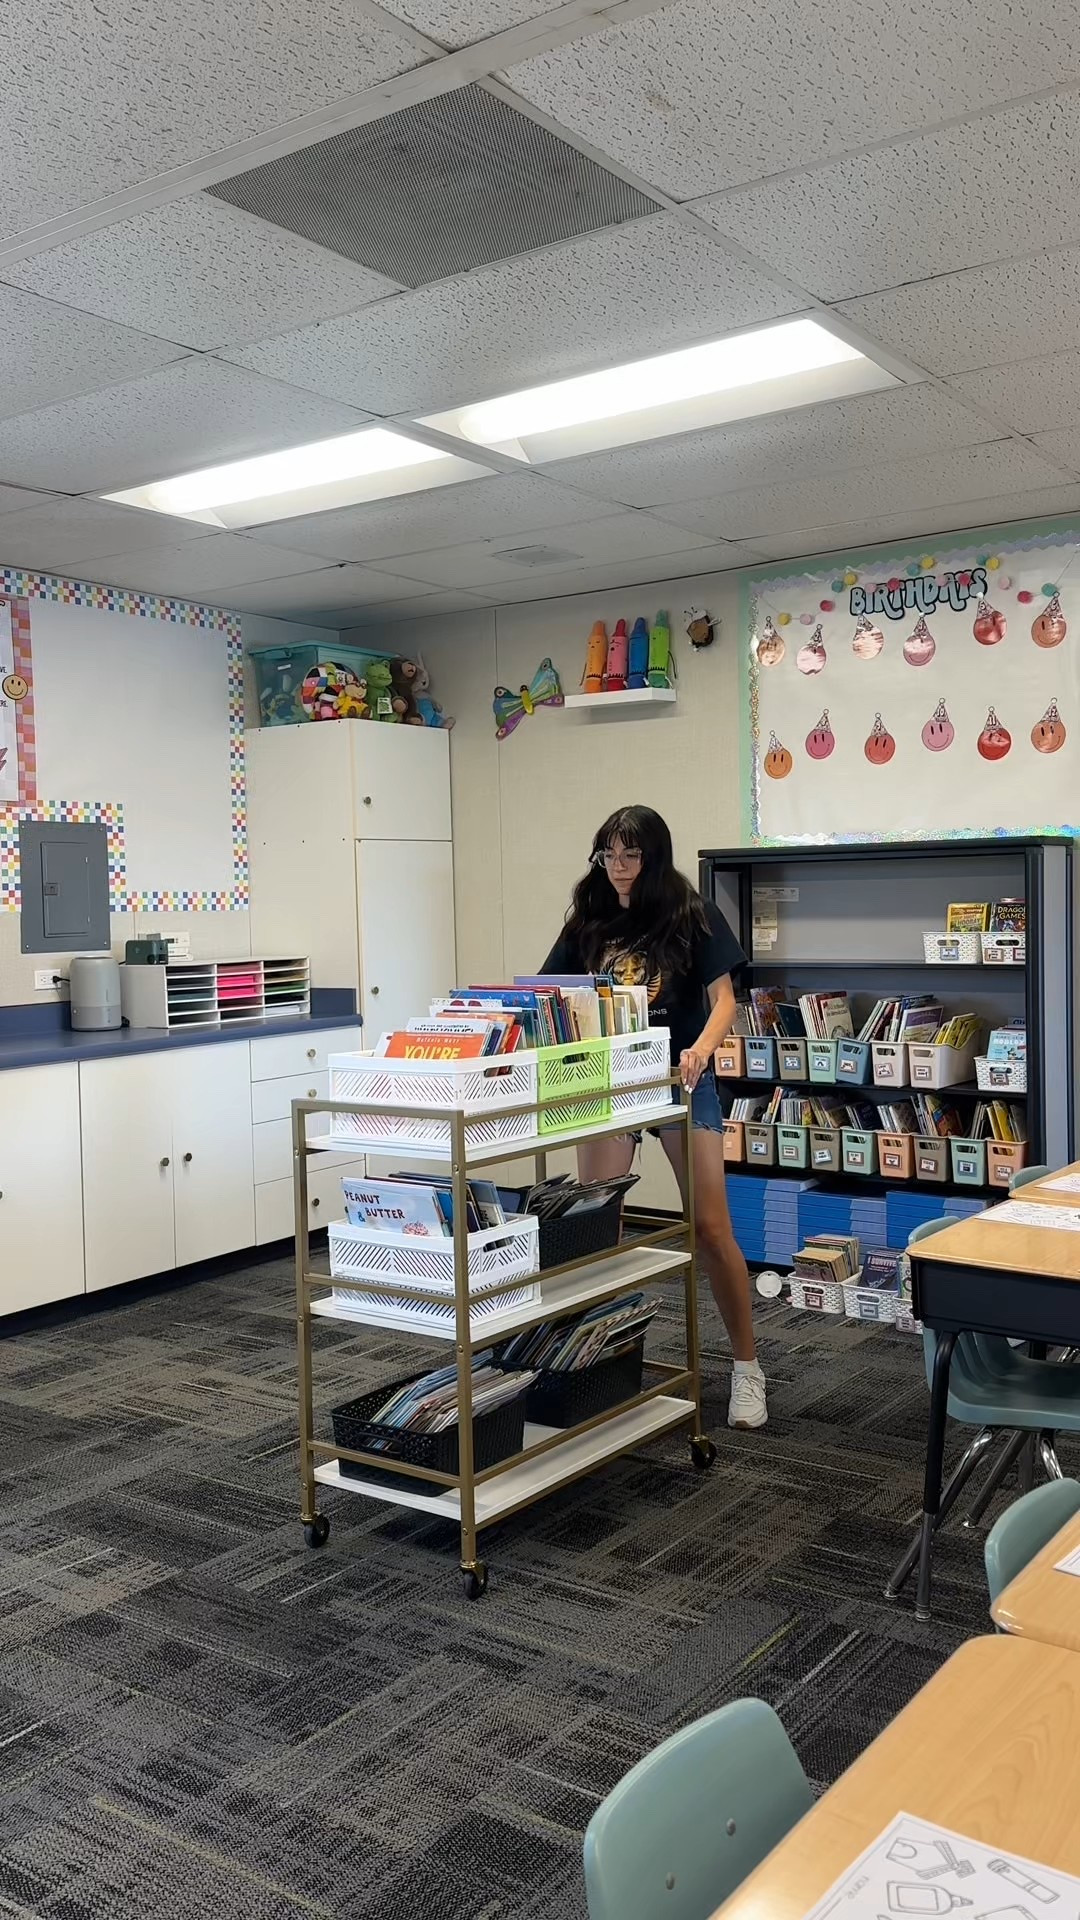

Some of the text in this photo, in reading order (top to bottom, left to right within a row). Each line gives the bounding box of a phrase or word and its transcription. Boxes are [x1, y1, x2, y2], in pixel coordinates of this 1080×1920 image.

[850, 567, 988, 620] BIRTHDAYS
[936, 705, 946, 717] 10
[1048, 706, 1058, 718] 12
[404, 1045, 461, 1060] YOU'RE
[344, 1190, 380, 1205] PEANUT
[364, 1207, 406, 1219] BUTTER
